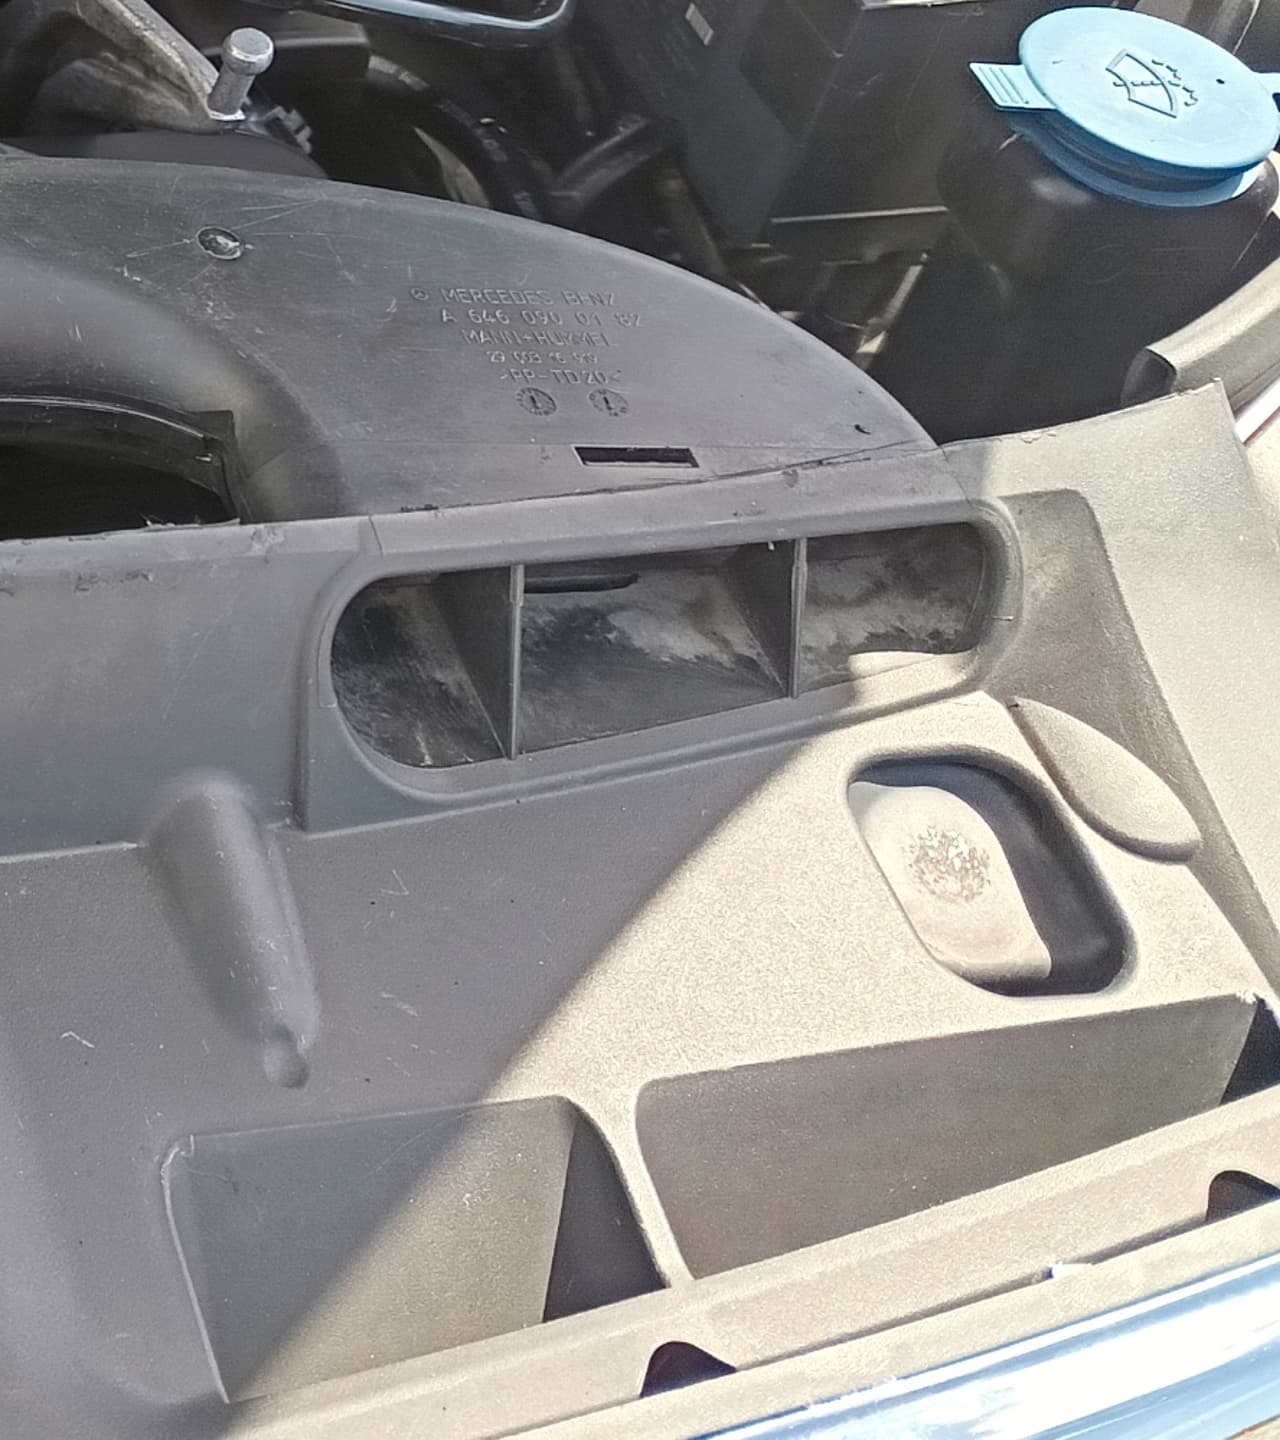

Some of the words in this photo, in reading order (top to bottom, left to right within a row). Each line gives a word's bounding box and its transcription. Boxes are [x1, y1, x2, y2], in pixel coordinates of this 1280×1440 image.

[440, 307, 457, 323] A
[467, 308, 512, 325] 646
[520, 309, 563, 326] 090
